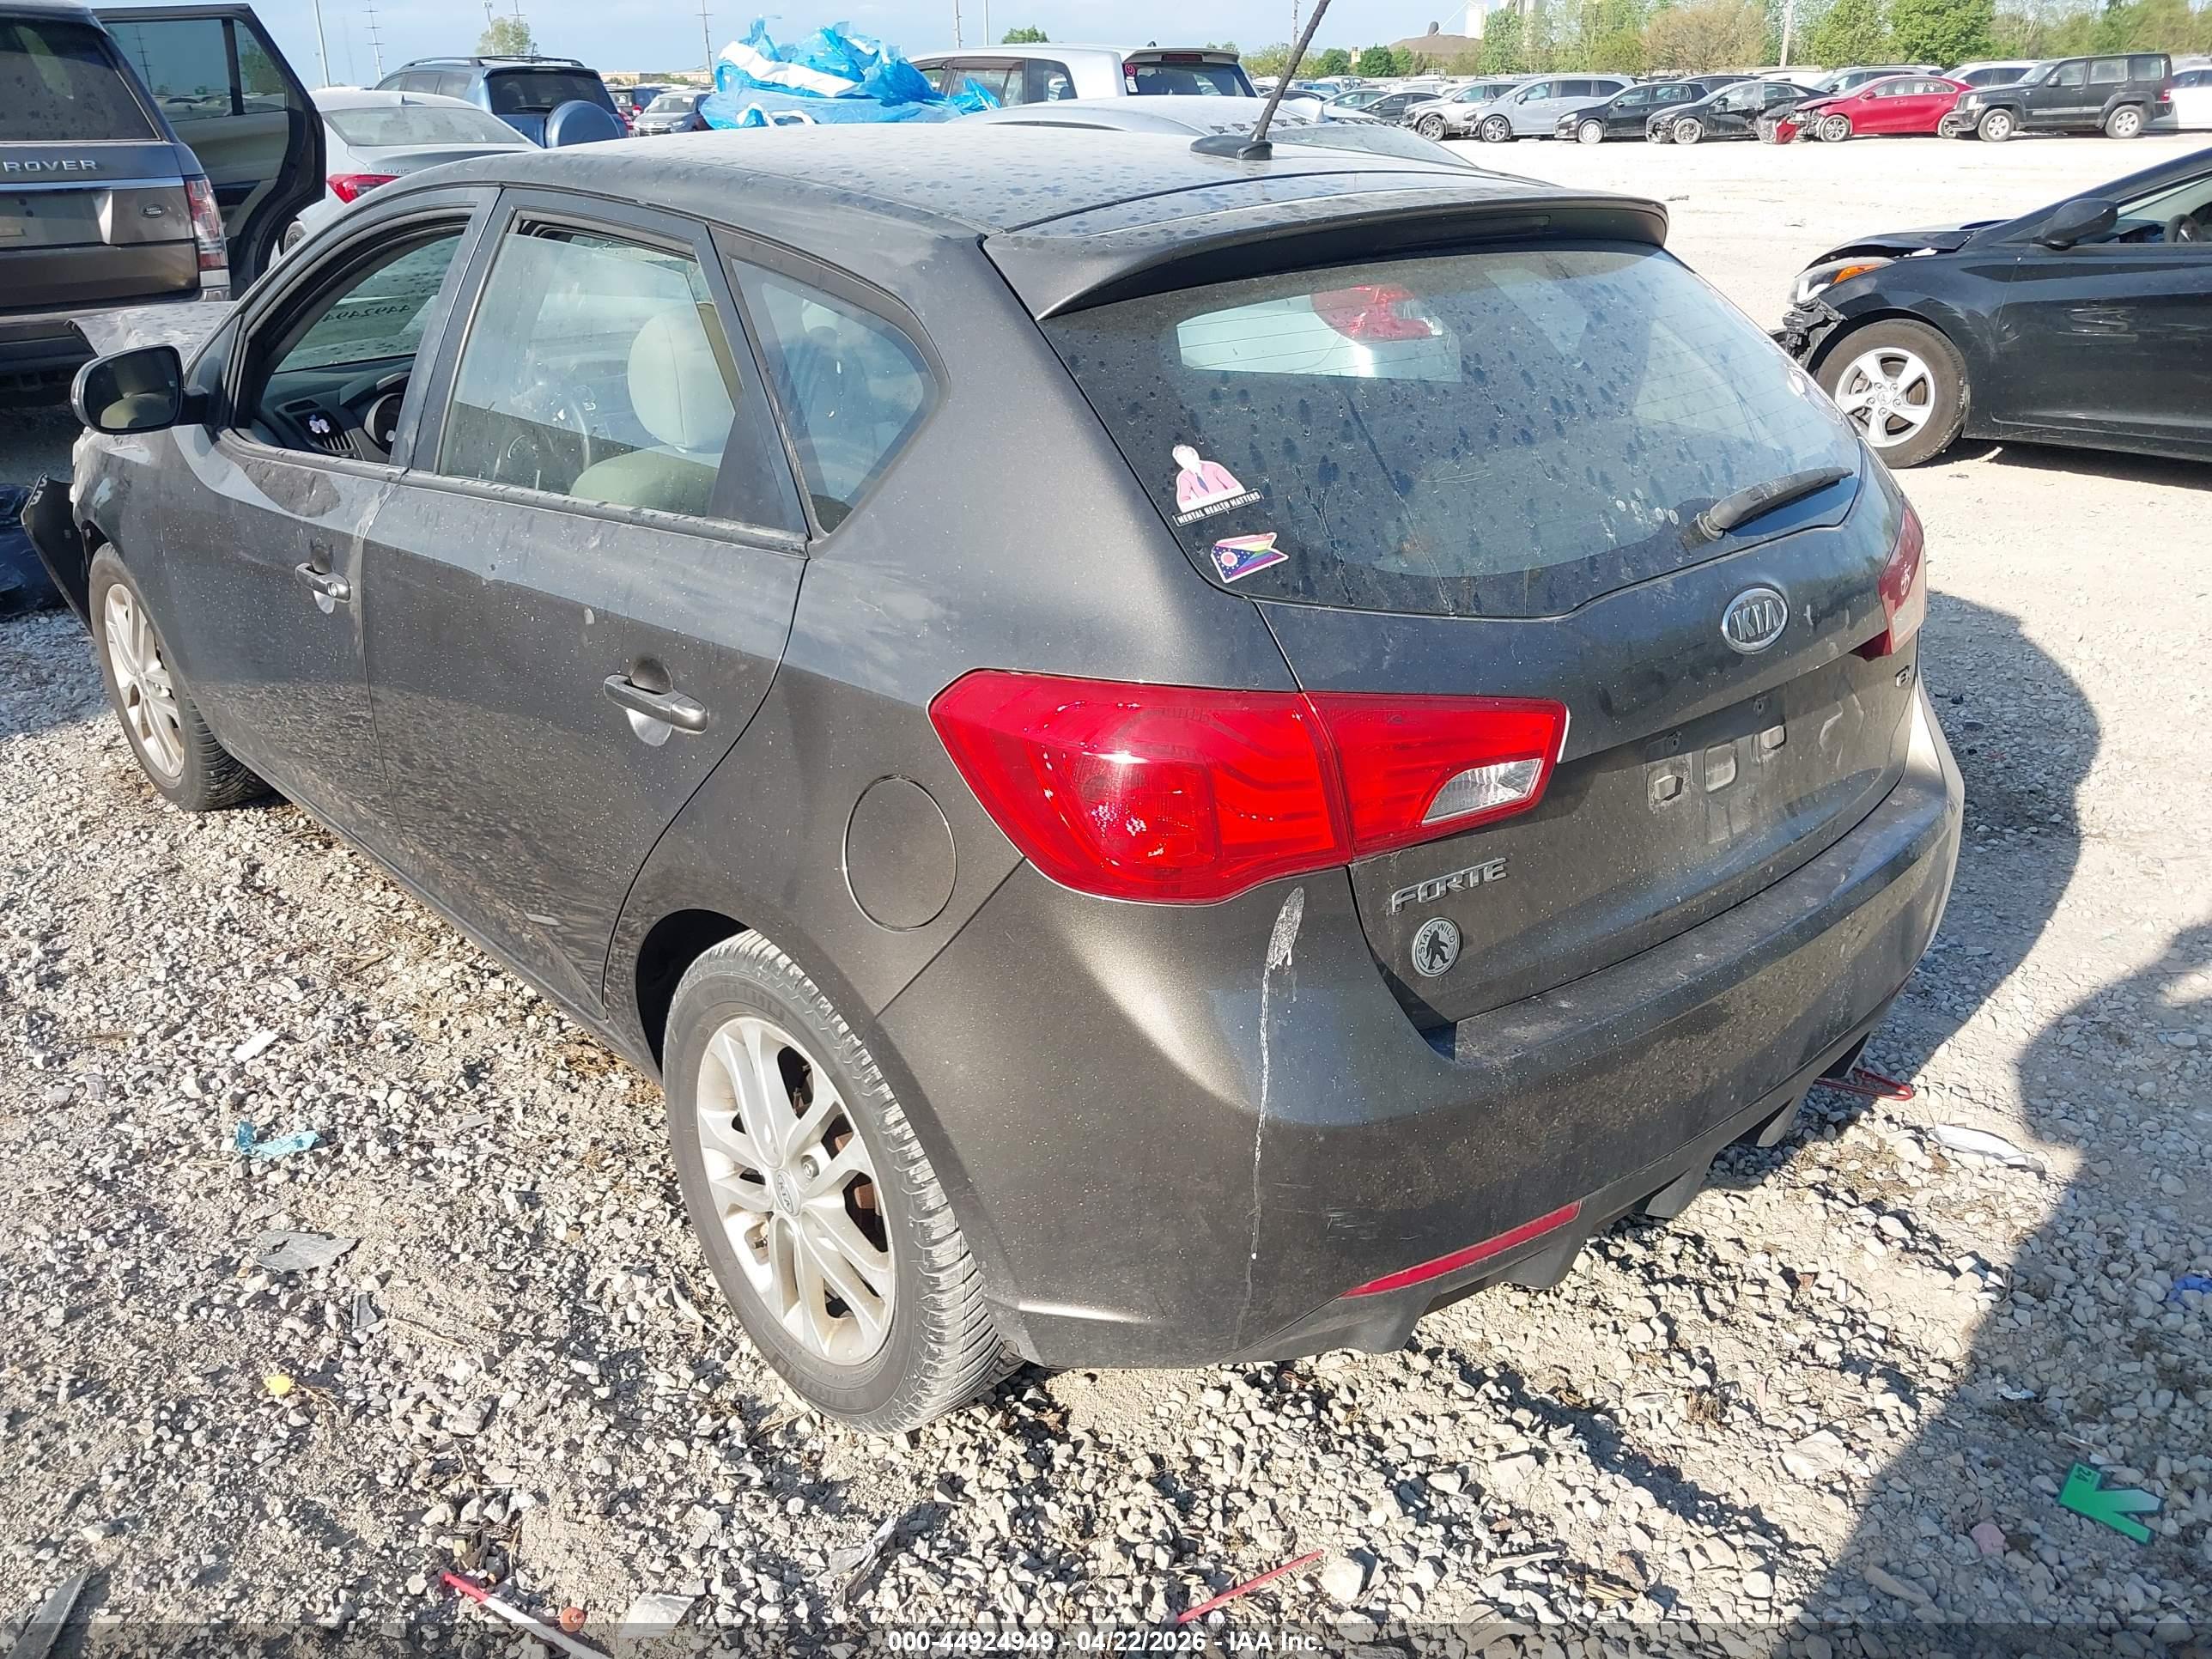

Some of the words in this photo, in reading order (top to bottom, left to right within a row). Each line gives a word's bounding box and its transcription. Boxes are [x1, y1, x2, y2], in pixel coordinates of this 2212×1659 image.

[3, 160, 98, 173] ROVER
[1176, 507, 1205, 525] MENTAL
[1204, 500, 1231, 515] HEALTH
[1231, 491, 1261, 507] MATTERS
[1733, 599, 1781, 641] KIA
[1391, 858, 1507, 914] FORTE
[1418, 927, 1434, 955] STAY
[1437, 922, 1455, 944] WILD
